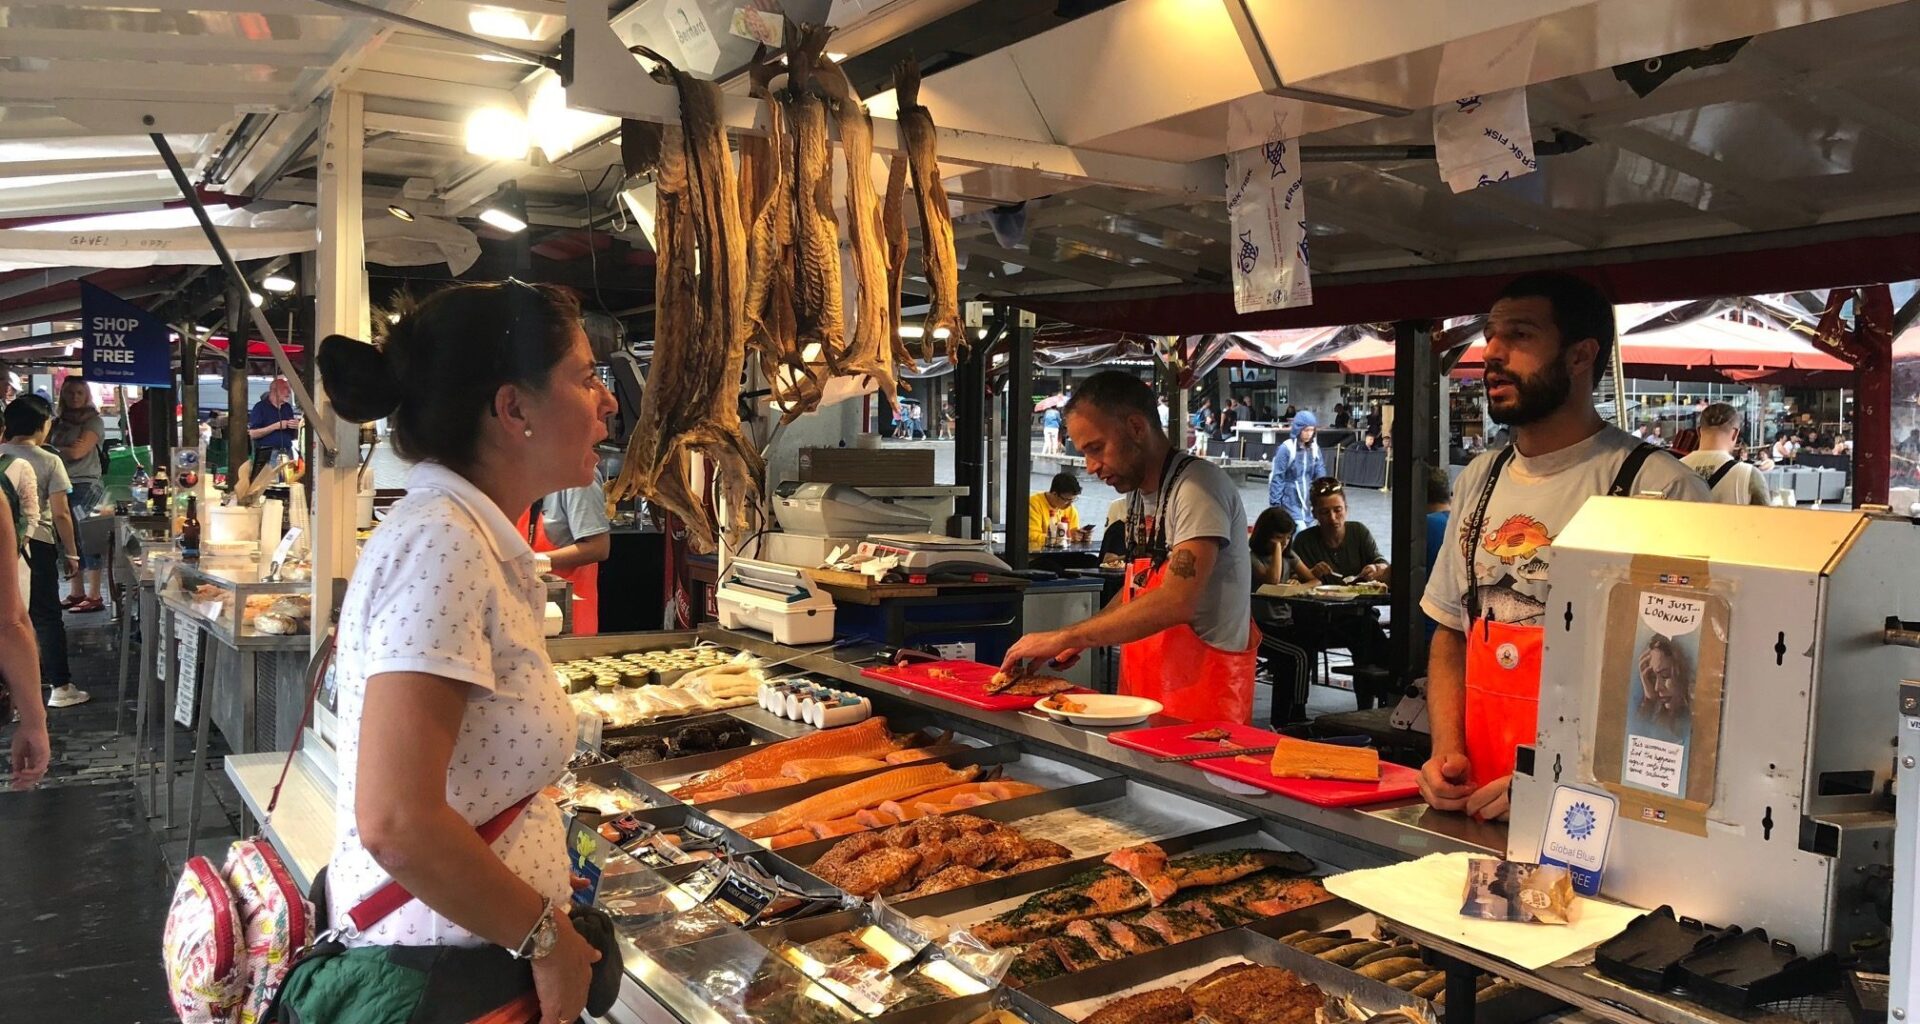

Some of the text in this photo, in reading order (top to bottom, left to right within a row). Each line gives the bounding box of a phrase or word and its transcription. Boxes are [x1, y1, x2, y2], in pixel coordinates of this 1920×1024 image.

[1483, 127, 1537, 170] ERSK FISK
[1241, 168, 1253, 192] FISK
[93, 317, 139, 331] SHOP
[93, 333, 125, 347] TAX
[93, 349, 135, 363] FREE
[1648, 596, 1664, 605] I'M
[1550, 842, 1595, 863] Global Blue
[1571, 871, 1592, 888] REE
